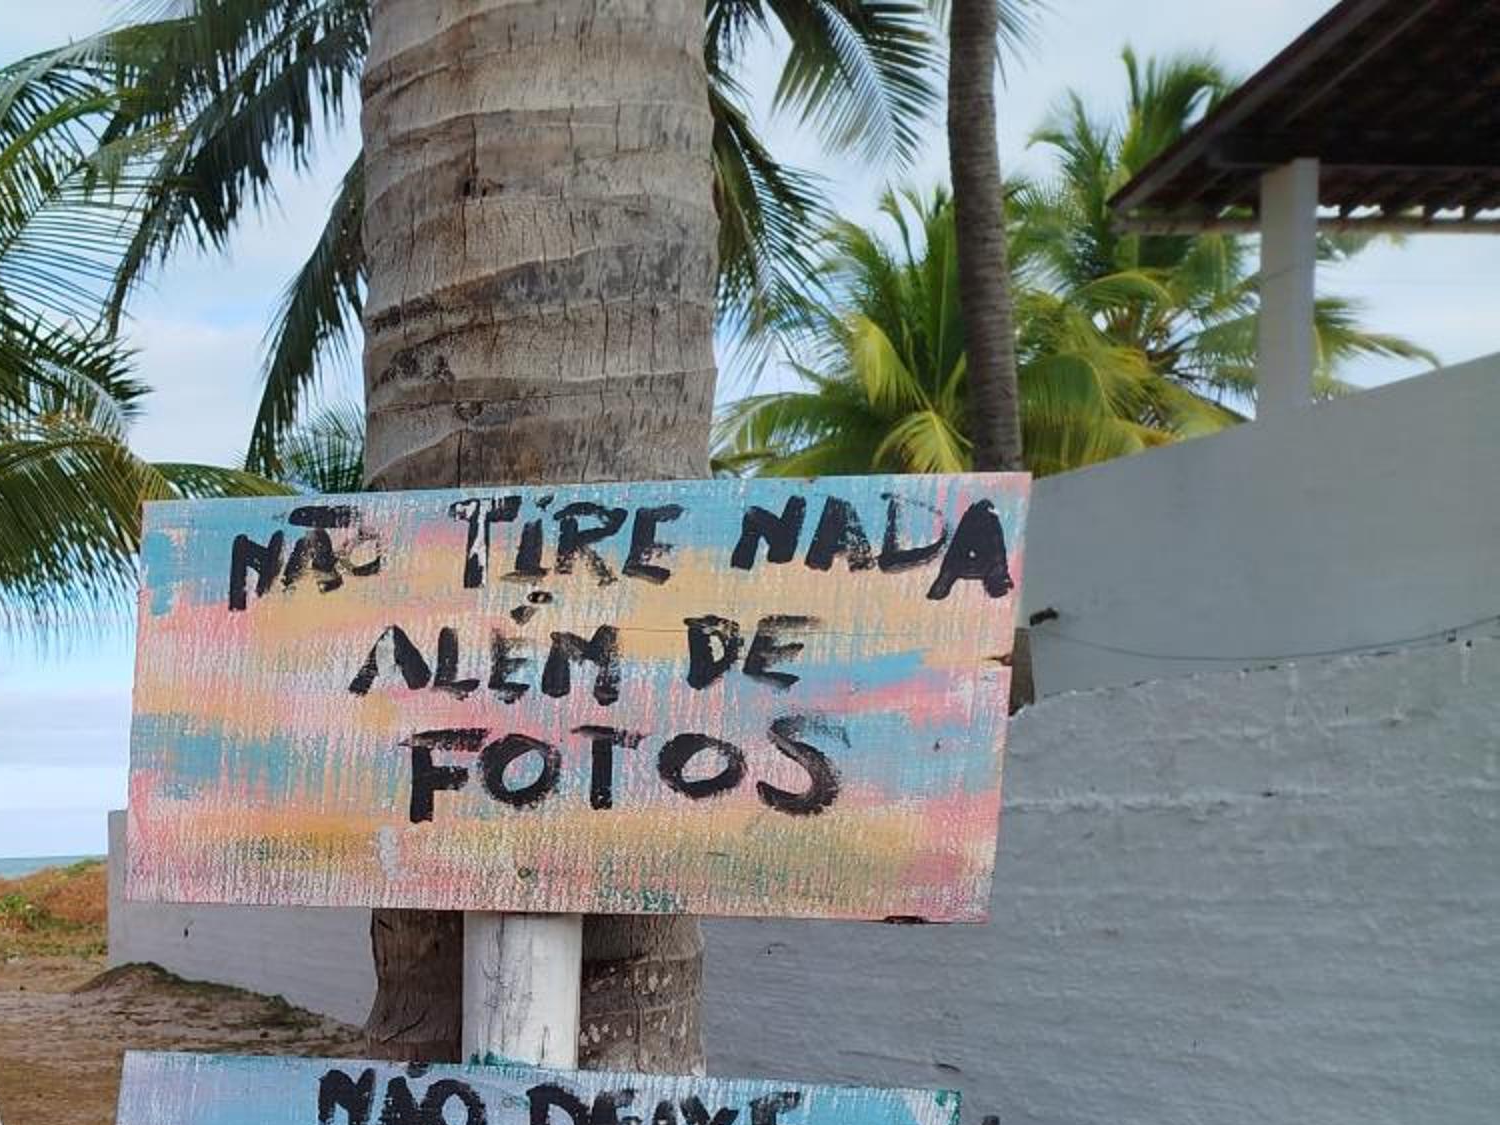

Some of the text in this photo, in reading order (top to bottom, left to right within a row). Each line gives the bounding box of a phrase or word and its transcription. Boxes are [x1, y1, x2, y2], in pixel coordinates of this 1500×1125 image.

[730, 491, 1015, 600] NADA
[349, 606, 822, 706] ALÉM DE
[400, 713, 850, 822] FOTOS
